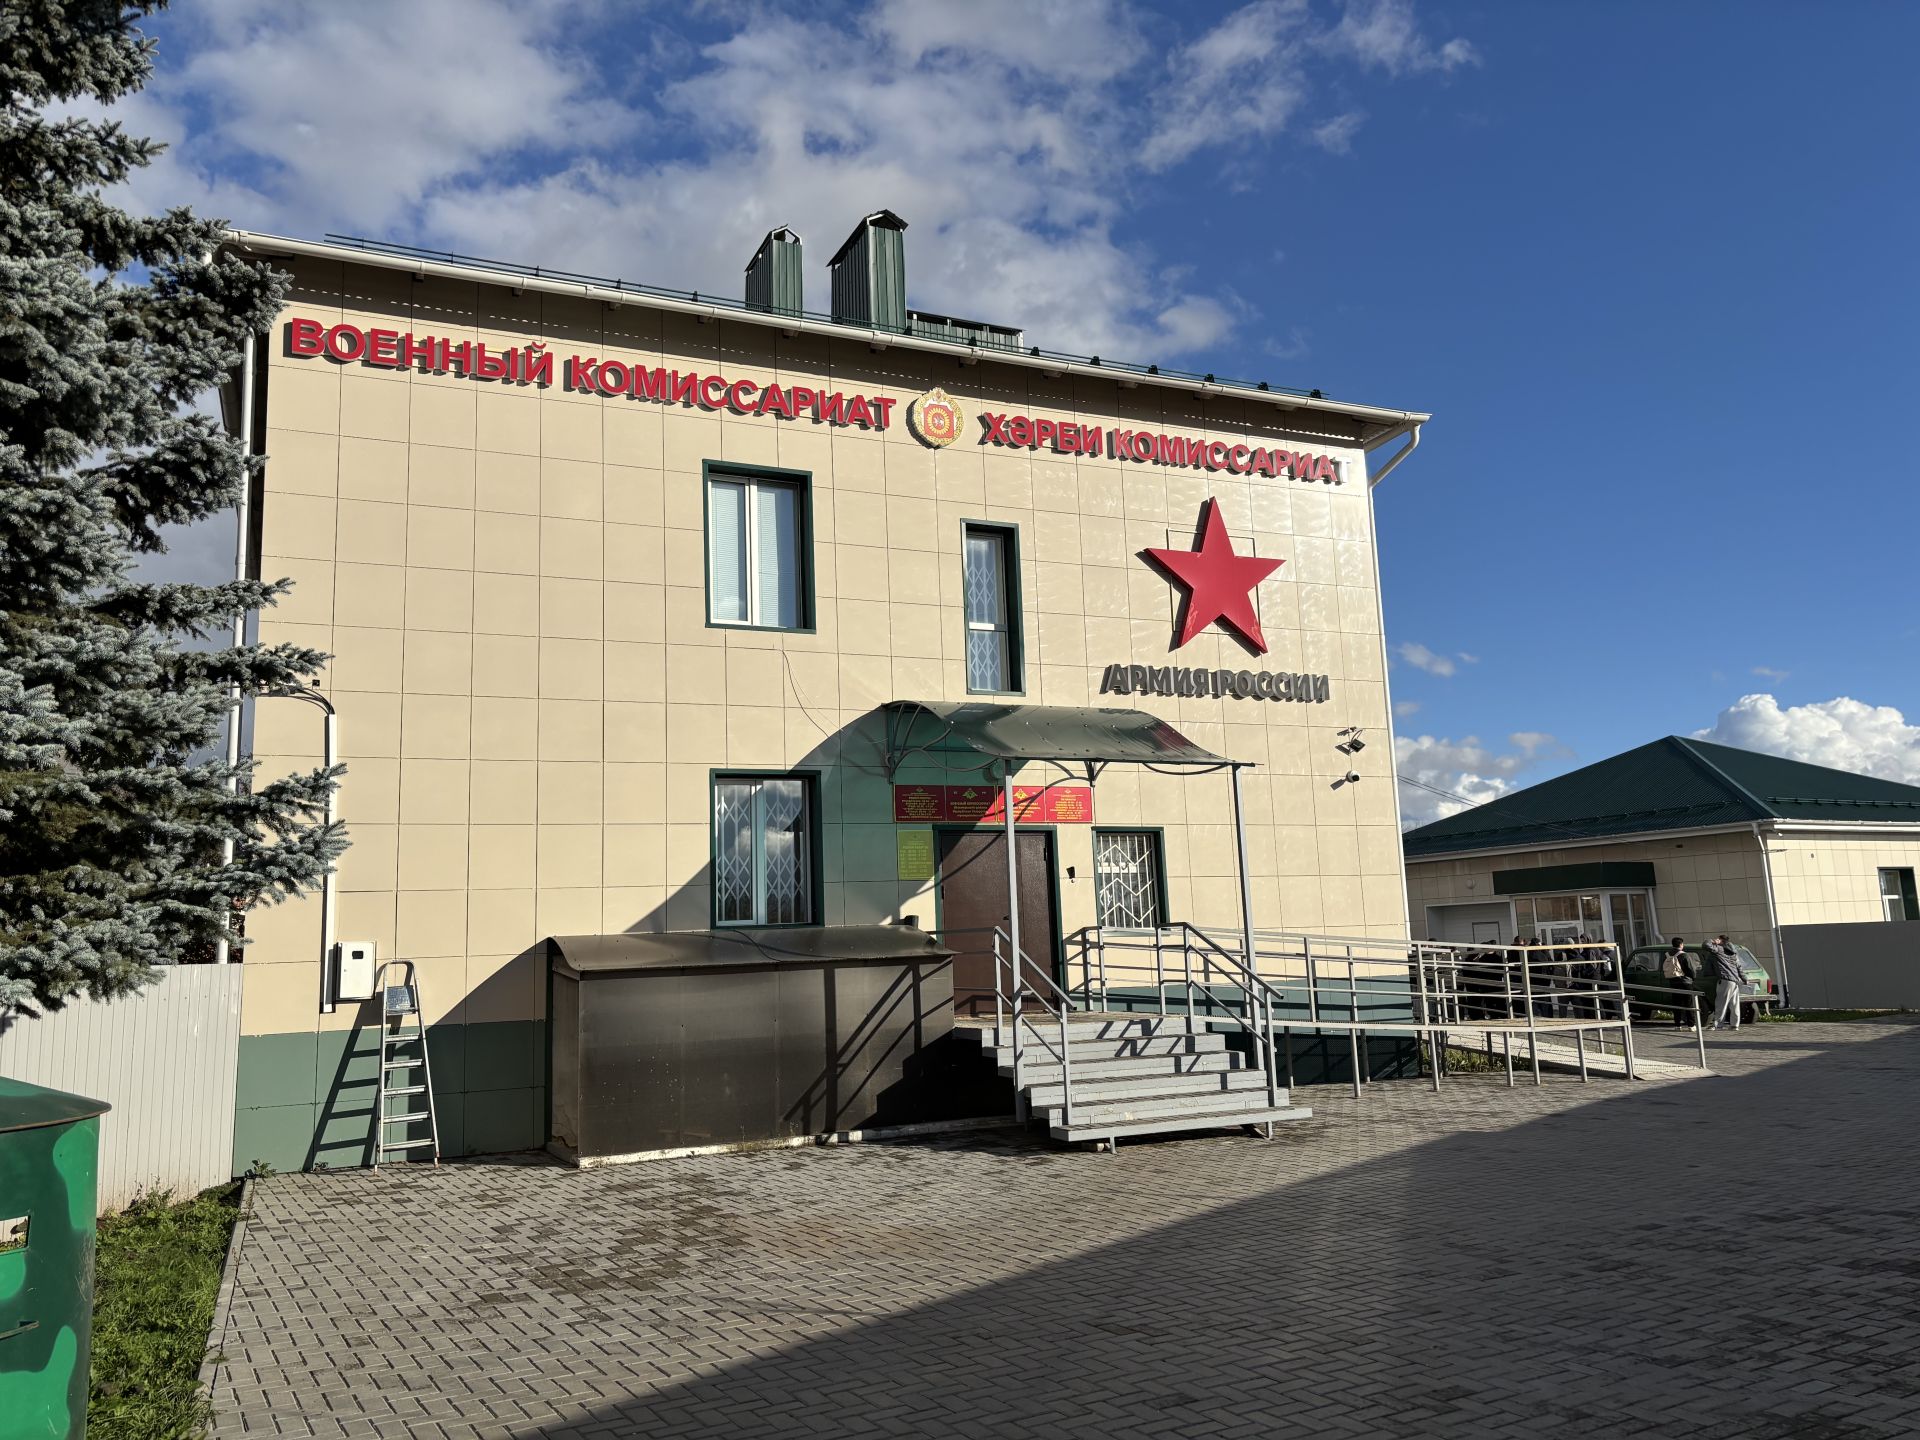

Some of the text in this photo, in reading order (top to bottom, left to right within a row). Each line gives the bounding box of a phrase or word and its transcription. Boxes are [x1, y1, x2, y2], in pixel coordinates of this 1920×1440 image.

[291, 317, 897, 429] ВОЕННЫЙ КОМИССАРИАТ
[982, 412, 1353, 484] ХӘРБИ КОМИССАРИАТ
[1105, 663, 1330, 701] АРМИЯ РОССИИ
